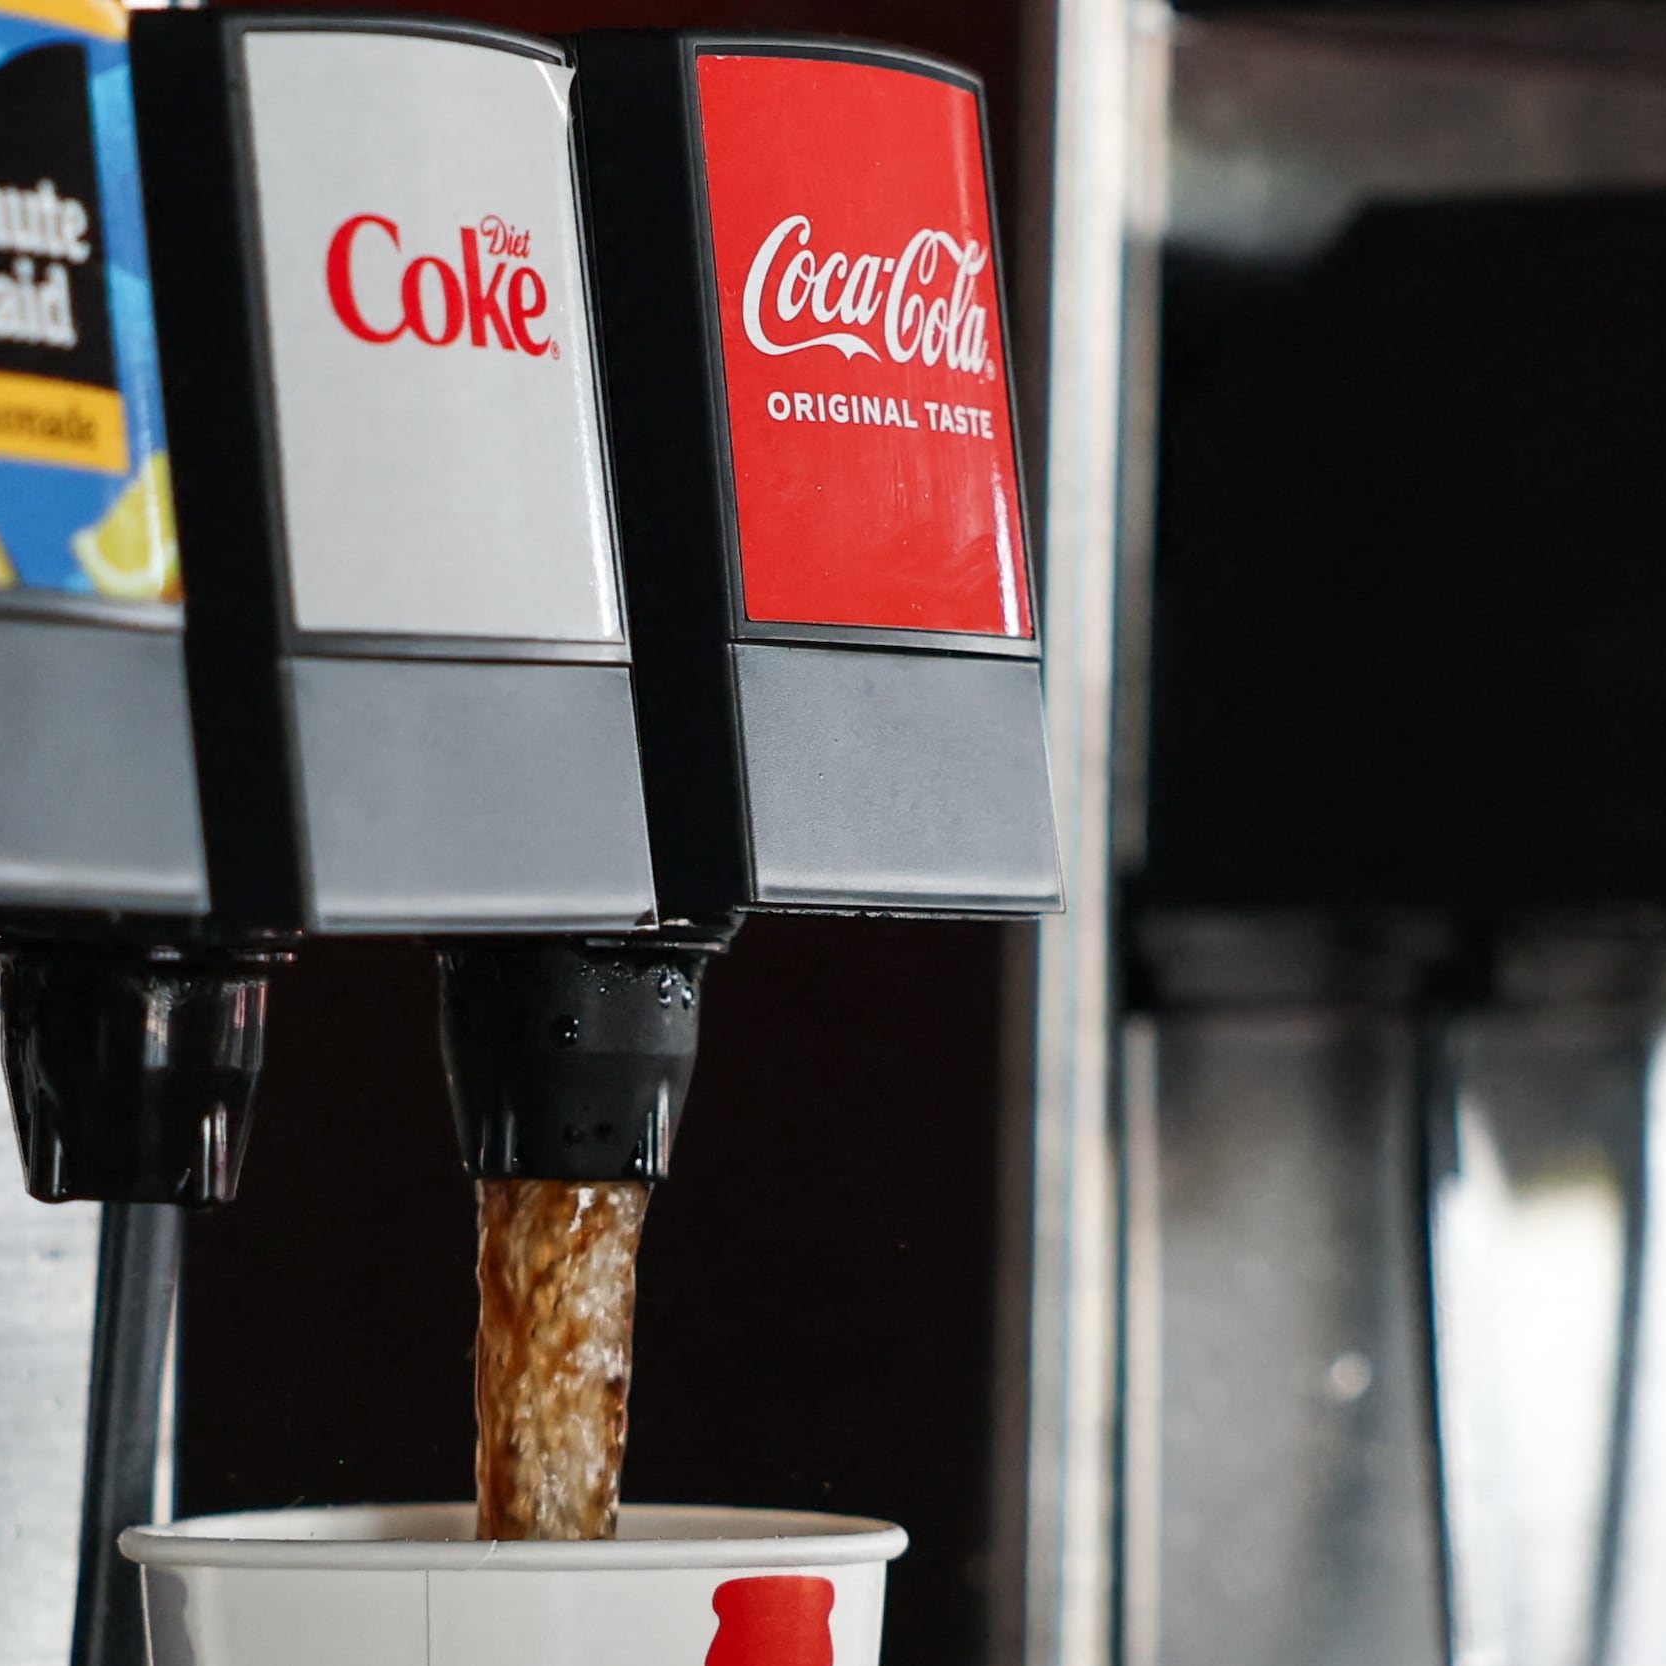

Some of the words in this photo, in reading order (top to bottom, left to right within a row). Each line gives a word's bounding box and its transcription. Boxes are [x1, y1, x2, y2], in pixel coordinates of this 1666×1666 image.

[325, 212, 552, 357] Coke
[480, 213, 531, 260] Diet
[742, 214, 989, 374] Coca-Cola
[766, 390, 920, 430] ORIGINAL
[924, 400, 995, 440] TASTE
